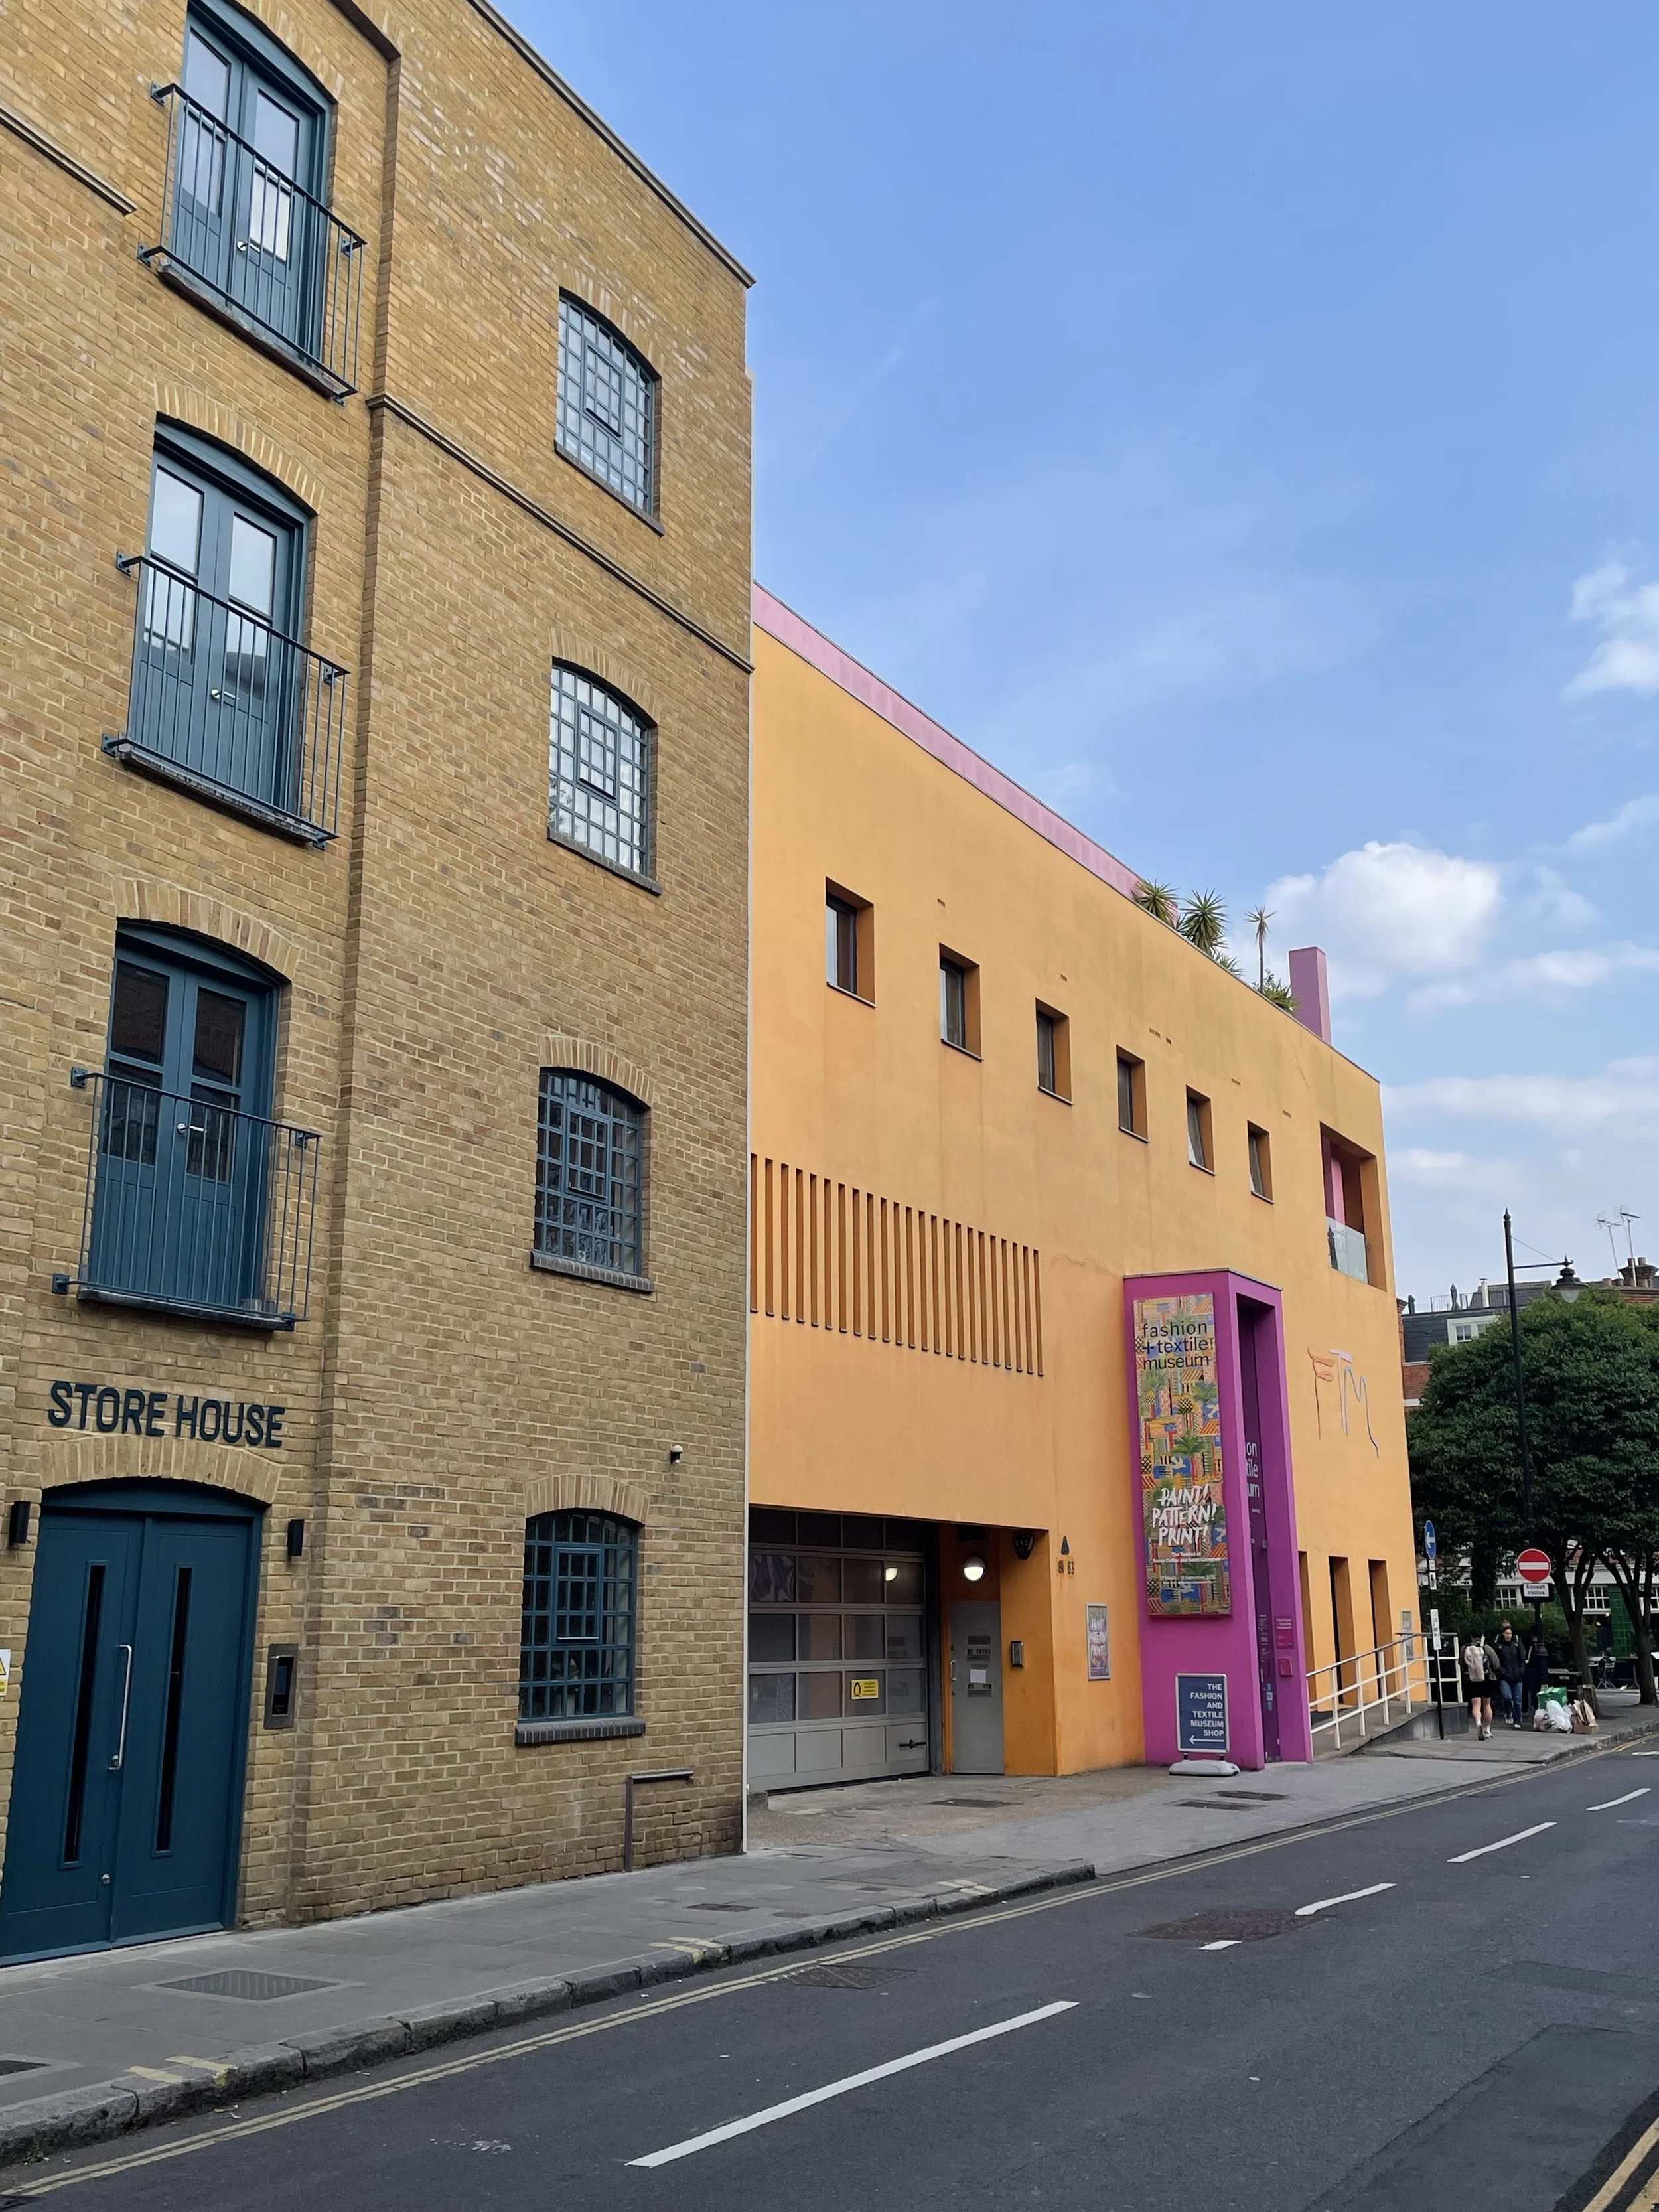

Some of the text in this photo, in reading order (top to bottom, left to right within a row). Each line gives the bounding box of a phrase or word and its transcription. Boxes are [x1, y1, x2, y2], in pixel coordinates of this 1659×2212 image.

[1141, 1321, 1207, 1338] fashion
[1143, 1355, 1209, 1370] museum
[48, 1380, 285, 1447] STORE HOUSE
[1157, 1483, 1208, 1507] PAINT!
[1152, 1503, 1217, 1528] PATTERN!
[1158, 1524, 1208, 1546] PRINT!
